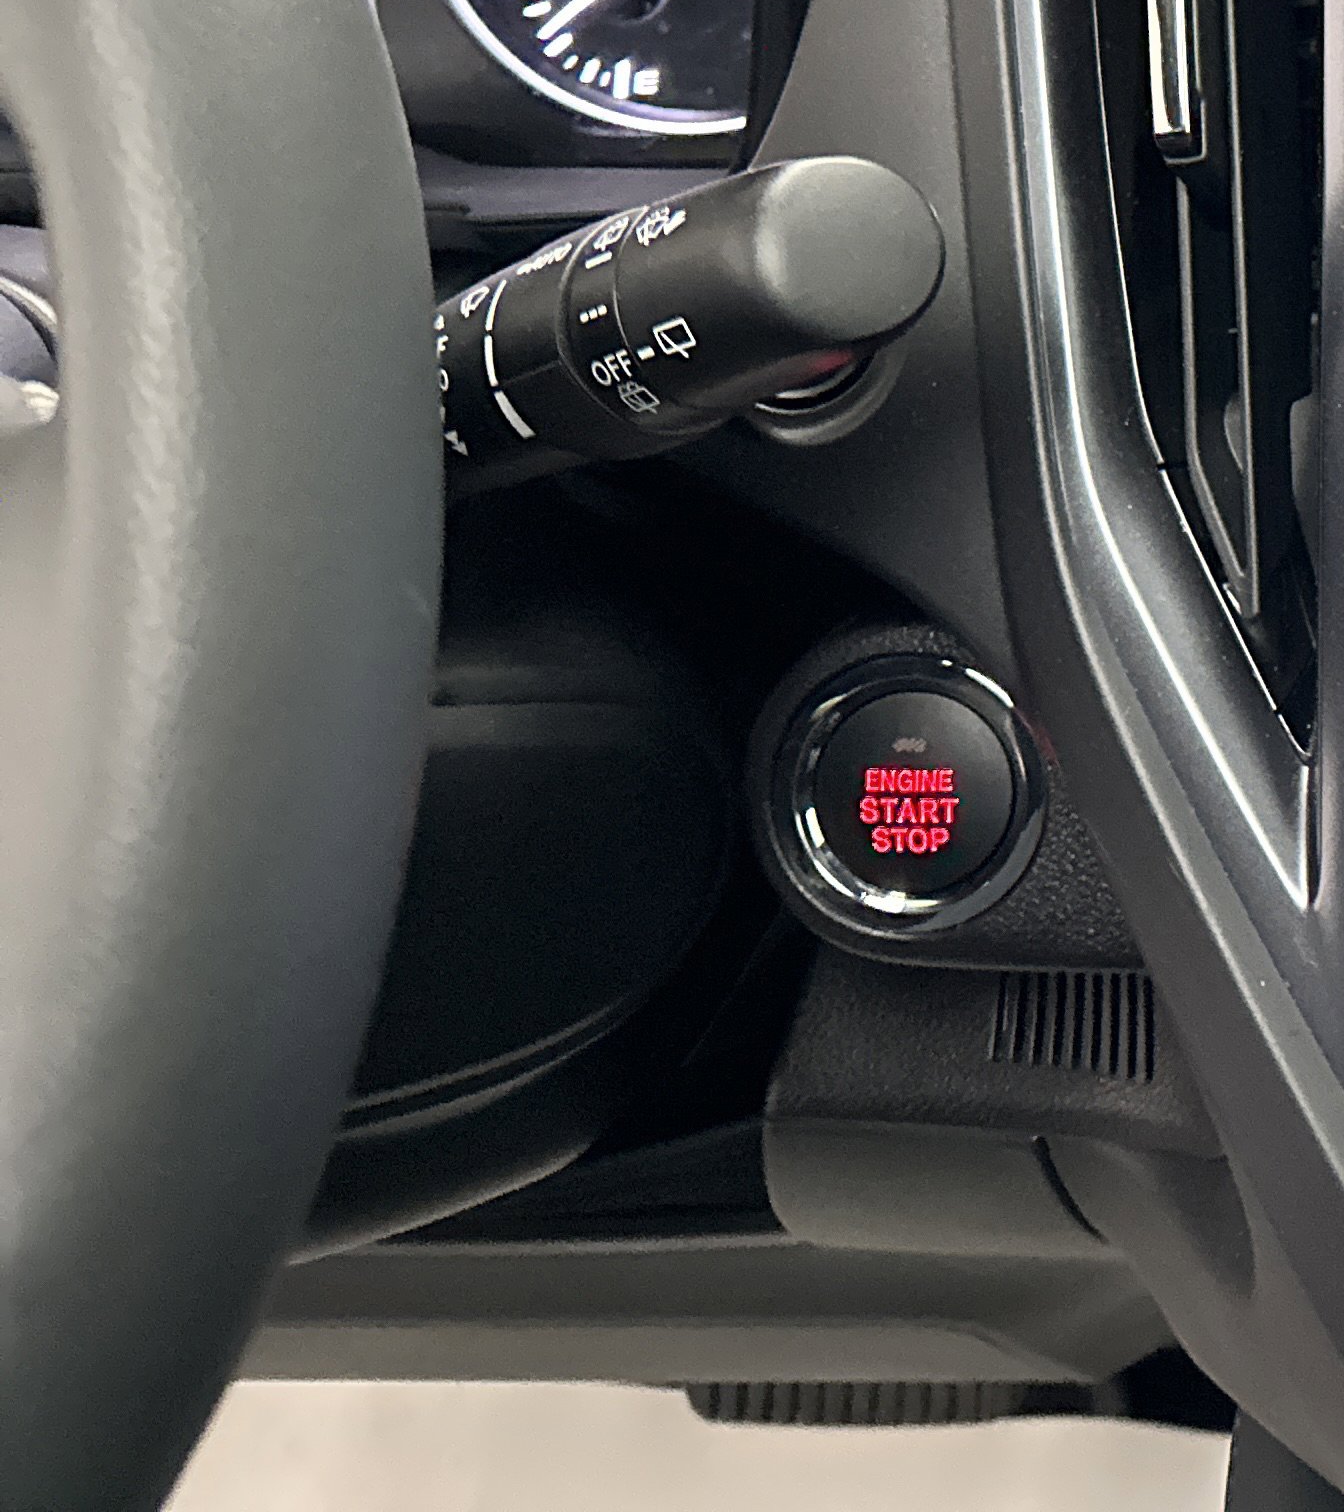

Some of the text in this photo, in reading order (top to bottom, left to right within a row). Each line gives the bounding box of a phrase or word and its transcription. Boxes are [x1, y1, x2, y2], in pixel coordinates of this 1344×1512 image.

[633, 69, 660, 96] E
[591, 349, 633, 387] OFF
[863, 767, 955, 793] ENGINE
[858, 796, 960, 824] START
[871, 826, 950, 855] STOP
